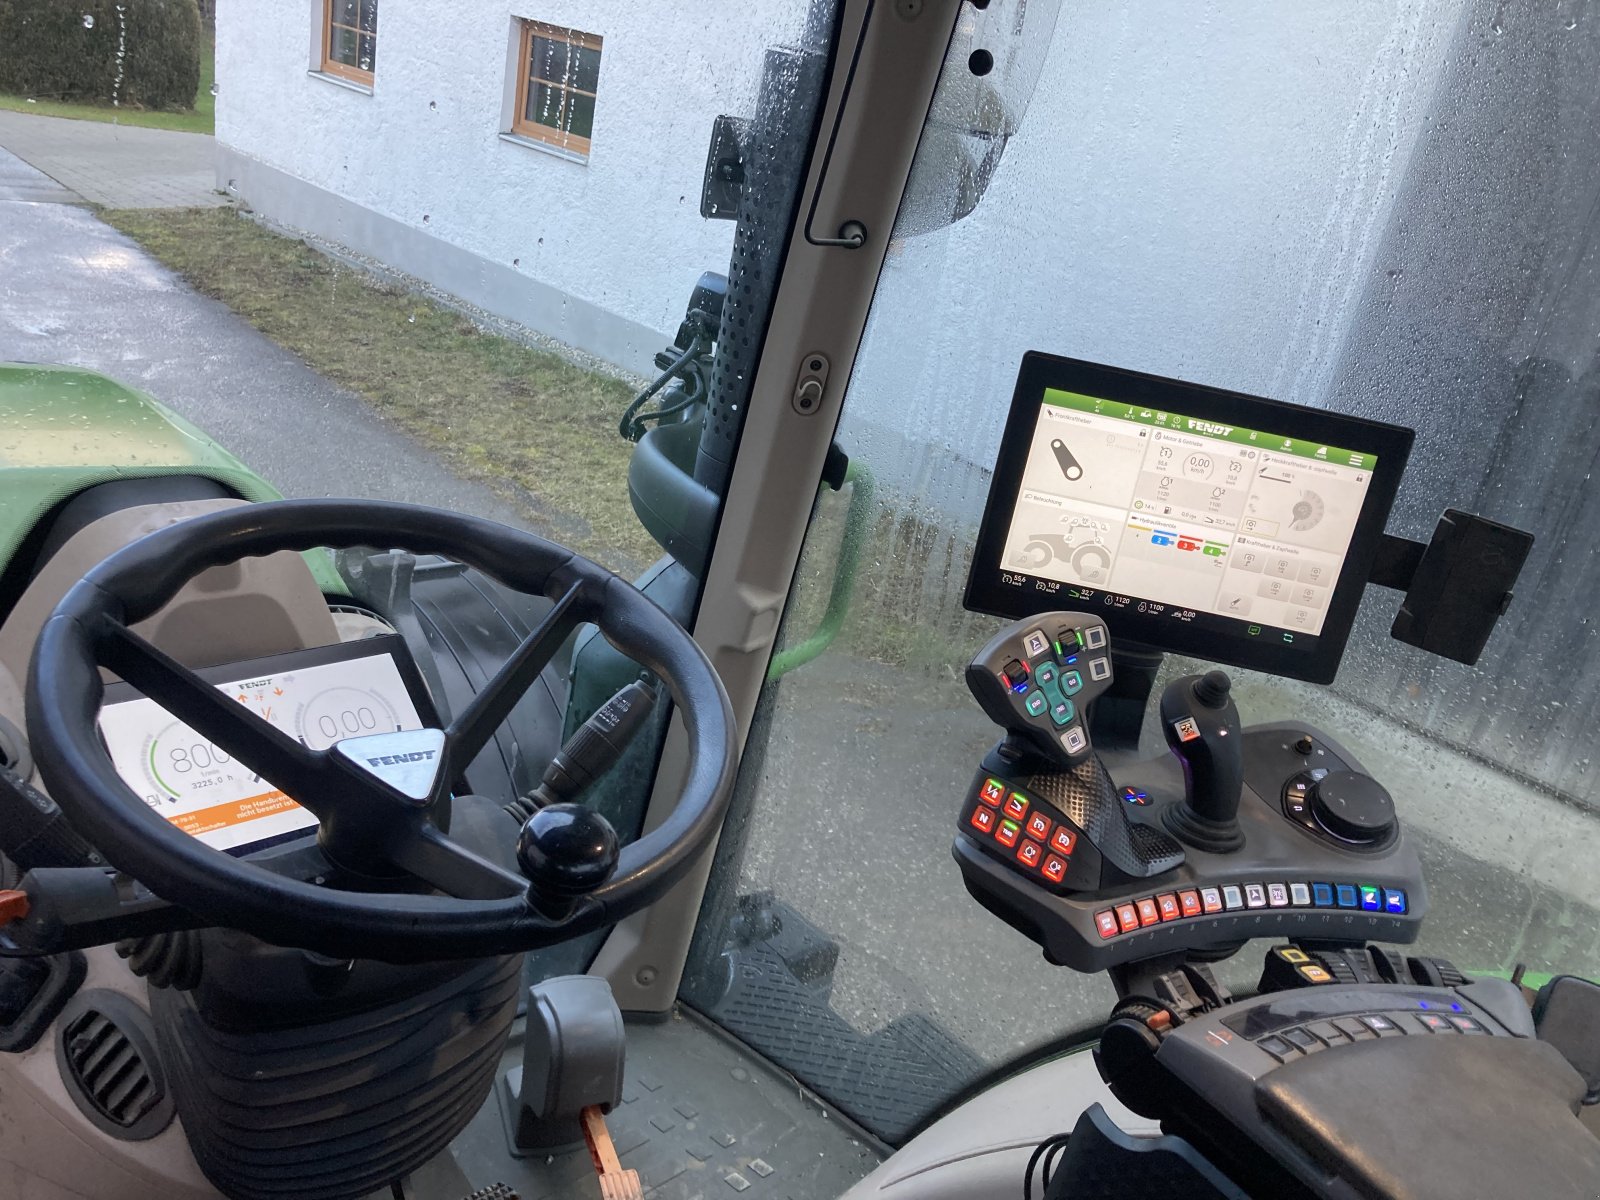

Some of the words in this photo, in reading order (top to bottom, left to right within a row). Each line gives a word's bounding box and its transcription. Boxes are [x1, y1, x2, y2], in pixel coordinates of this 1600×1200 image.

[1054, 412, 1092, 424] Frontkraftheber
[1188, 419, 1234, 436] FENDT
[1163, 434, 1178, 443] Motor
[1183, 438, 1203, 447] Getriebe
[1190, 456, 1210, 468] 0,00
[1190, 466, 1205, 474] km/h
[1033, 495, 1062, 507] Beleuchtung
[1246, 539, 1271, 549] Kraftheber
[1276, 545, 1299, 555] Zapfwelle
[1013, 574, 1026, 583] 55,6
[1048, 582, 1060, 590] 10,8
[1116, 596, 1130, 604] 1120
[1149, 603, 1164, 612] 1100
[1183, 610, 1196, 618] 0,00
[238, 678, 273, 690] FENDT
[318, 707, 376, 738] 0,00
[366, 750, 436, 768] FENDT
[200, 769, 220, 777] 1/min
[191, 776, 224, 790] 3225,0
[228, 774, 233, 782] h
[236, 810, 256, 819] nicht
[256, 803, 283, 814] besetzt
[979, 812, 988, 824] N
[1344, 916, 1353, 924] 12
